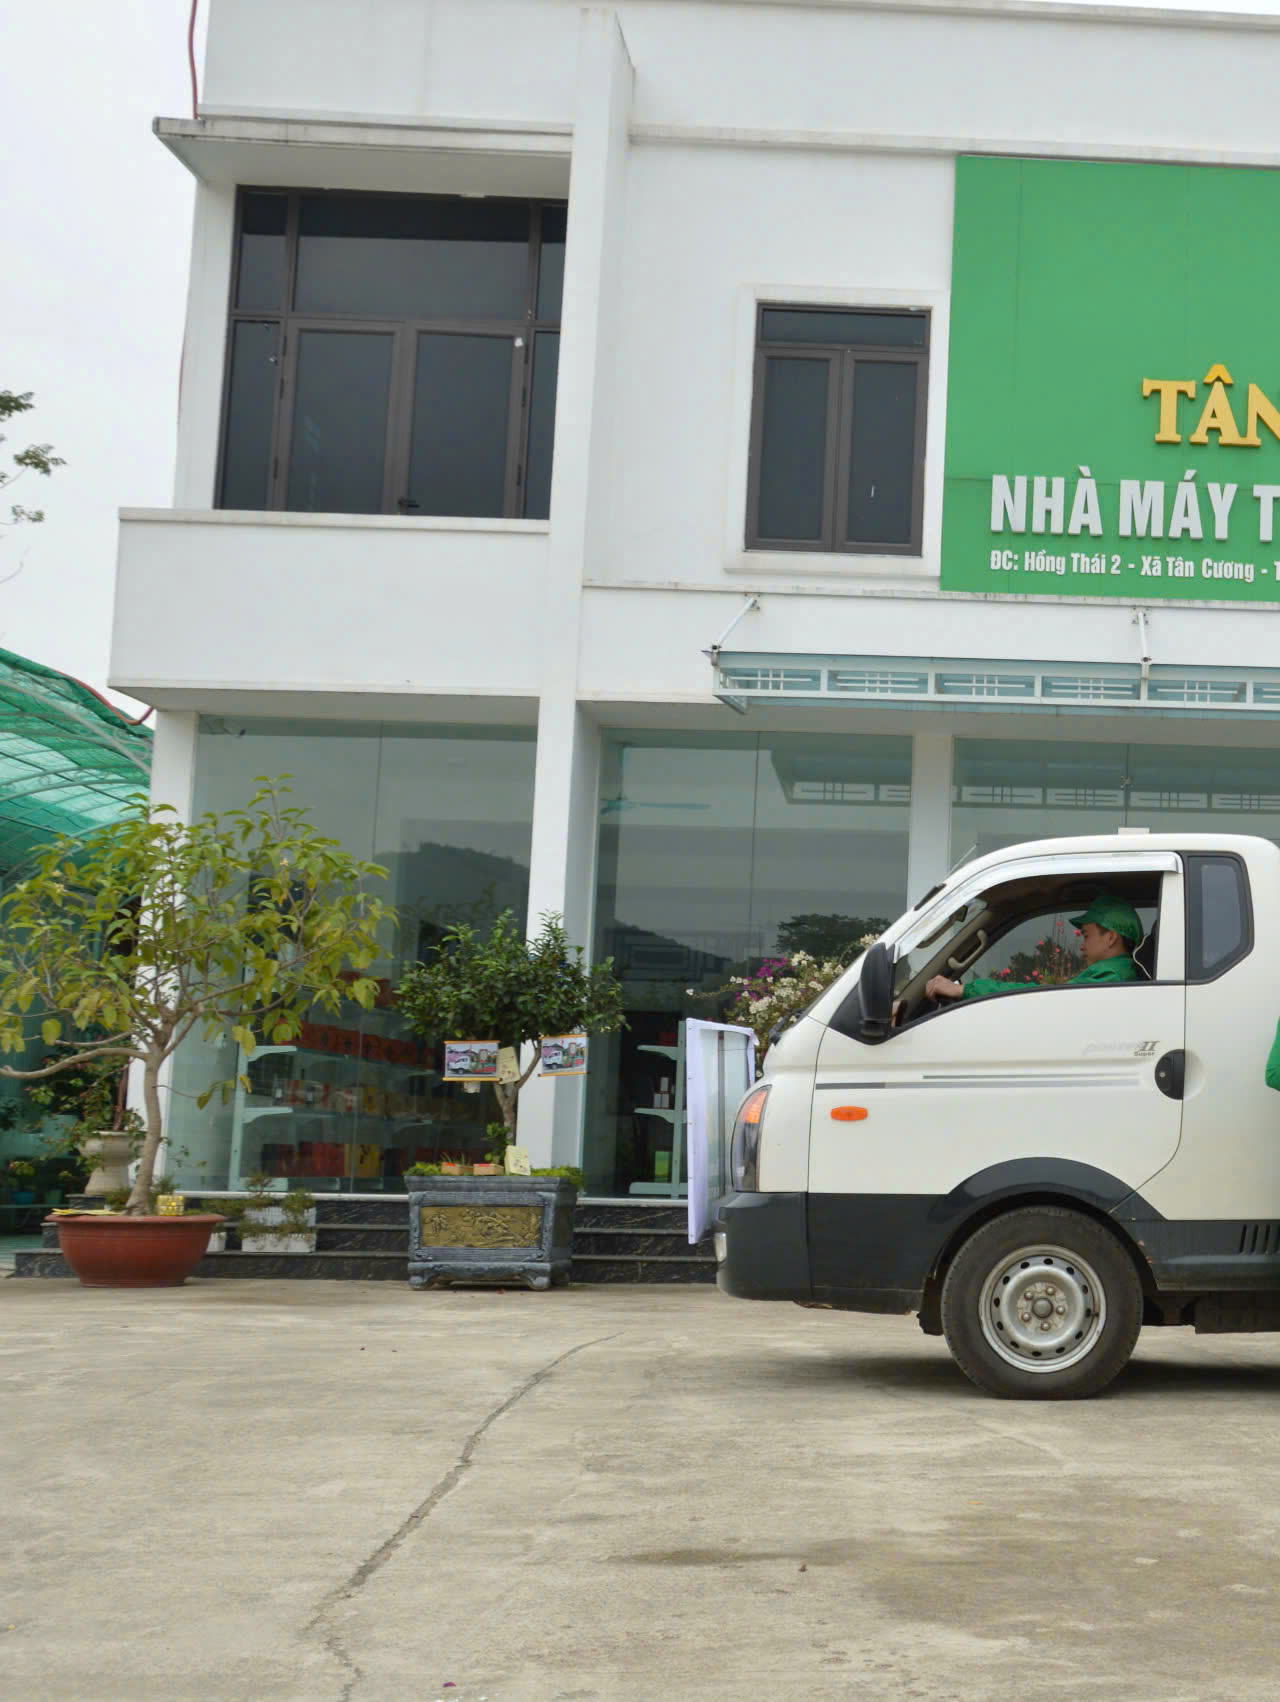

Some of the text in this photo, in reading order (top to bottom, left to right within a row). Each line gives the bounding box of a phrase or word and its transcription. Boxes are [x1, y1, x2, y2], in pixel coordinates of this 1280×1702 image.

[990, 465, 1103, 536] NHÀ
[1118, 470, 1238, 541] MÁY
[990, 550, 1019, 570] ĐC:
[1024, 549, 1066, 575] Hồng
[1071, 553, 1106, 574] Thái
[1110, 555, 1121, 574] 2
[1140, 556, 1162, 576] Xã
[1166, 557, 1195, 577] Tân
[1201, 558, 1254, 583] Cương
